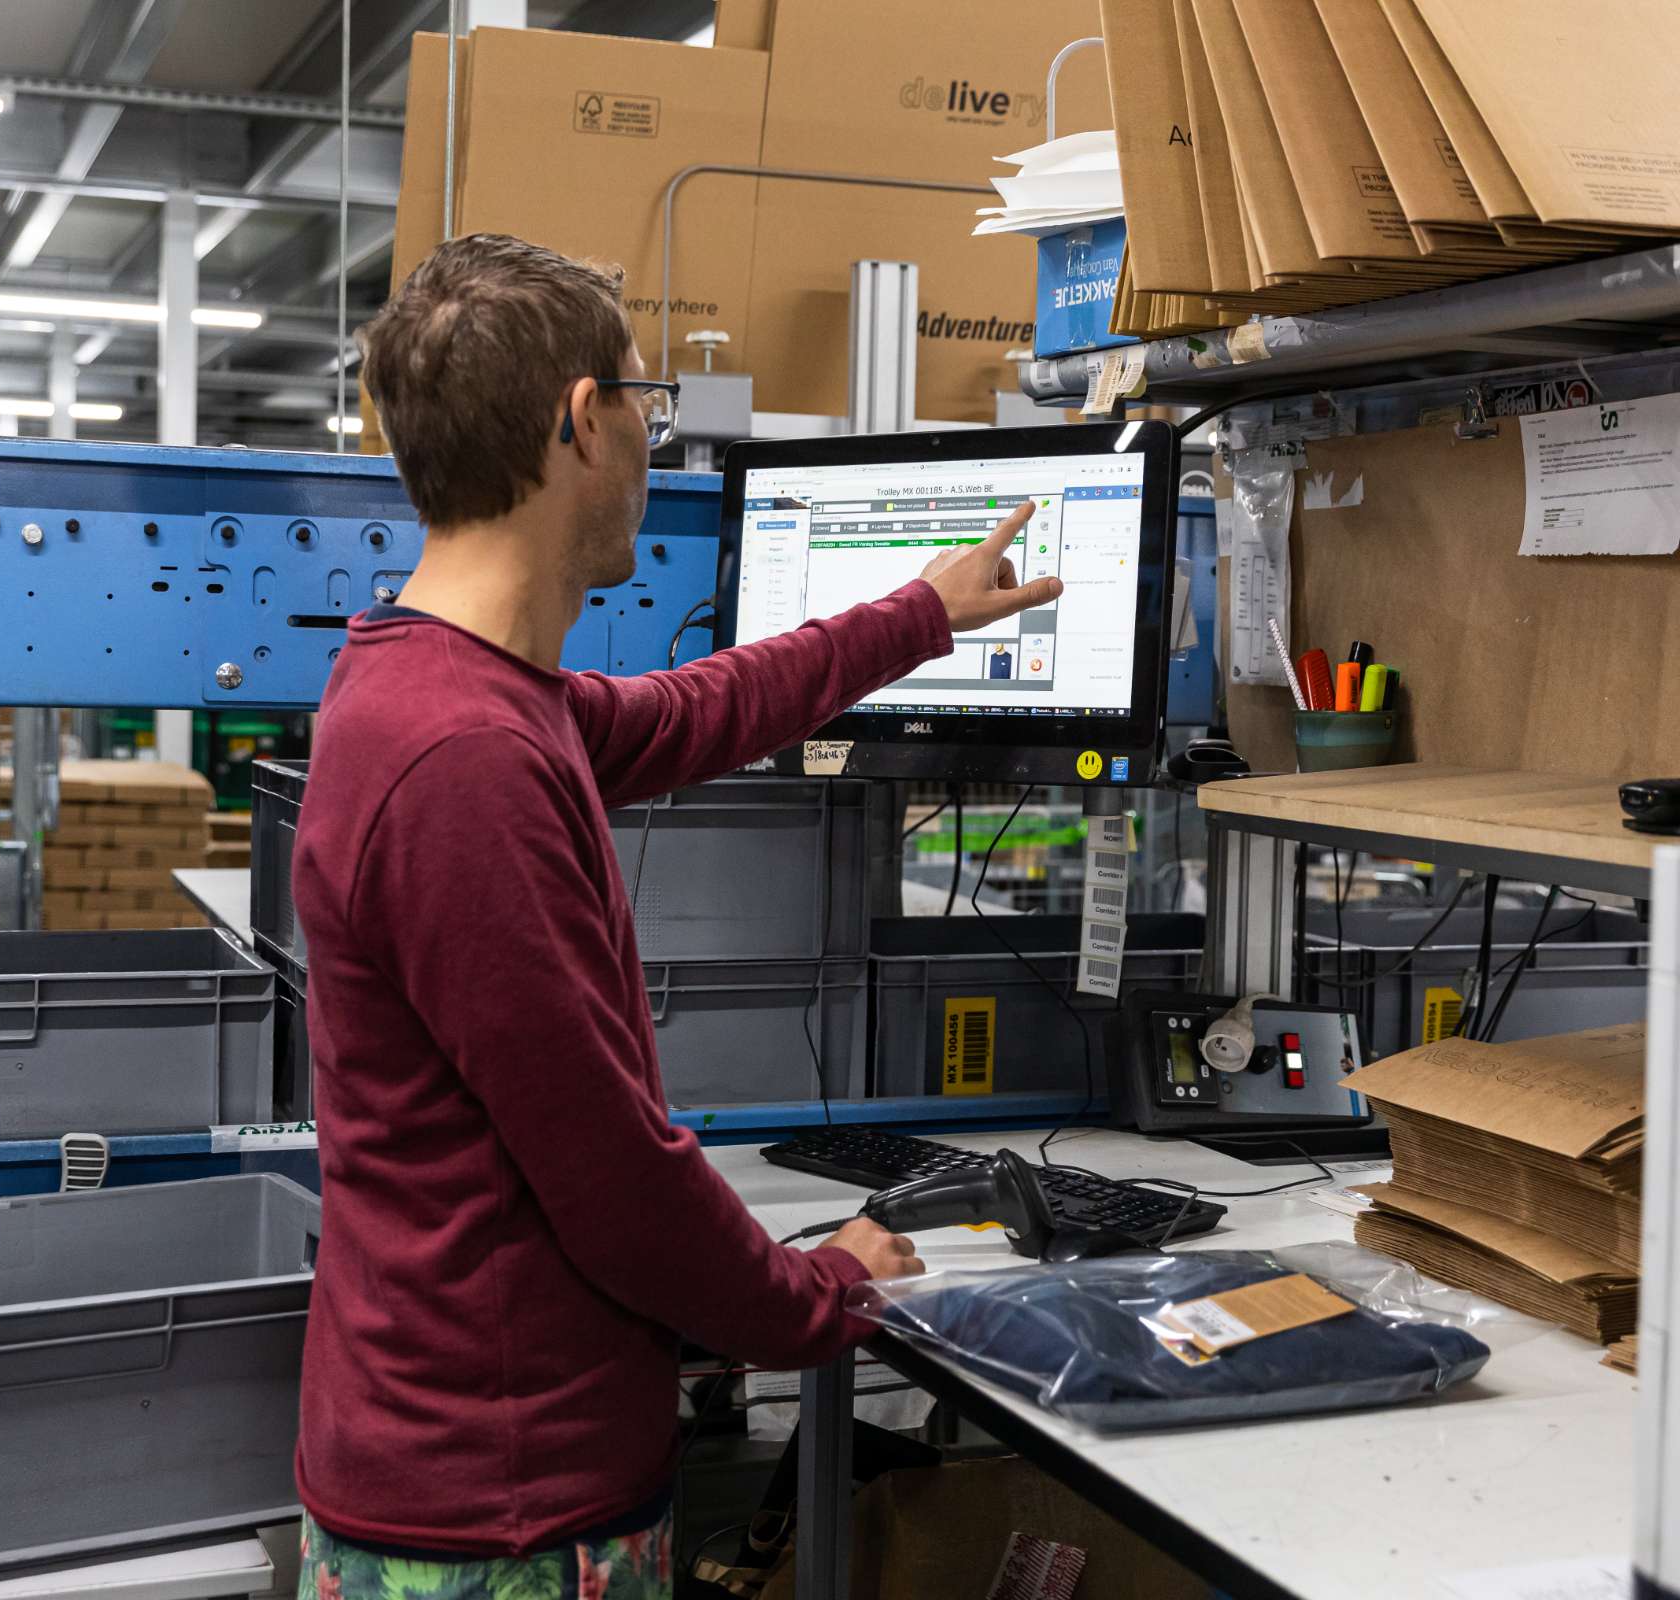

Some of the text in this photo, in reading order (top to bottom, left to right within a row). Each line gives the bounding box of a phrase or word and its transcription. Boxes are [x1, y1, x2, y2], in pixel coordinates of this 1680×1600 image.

[877, 487, 901, 497] Trolley
[902, 487, 913, 495] MX
[915, 486, 943, 495] 001185
[984, 484, 994, 493] BE
[904, 722, 933, 734] DELL
[947, 1013, 959, 1084] MX 100456
